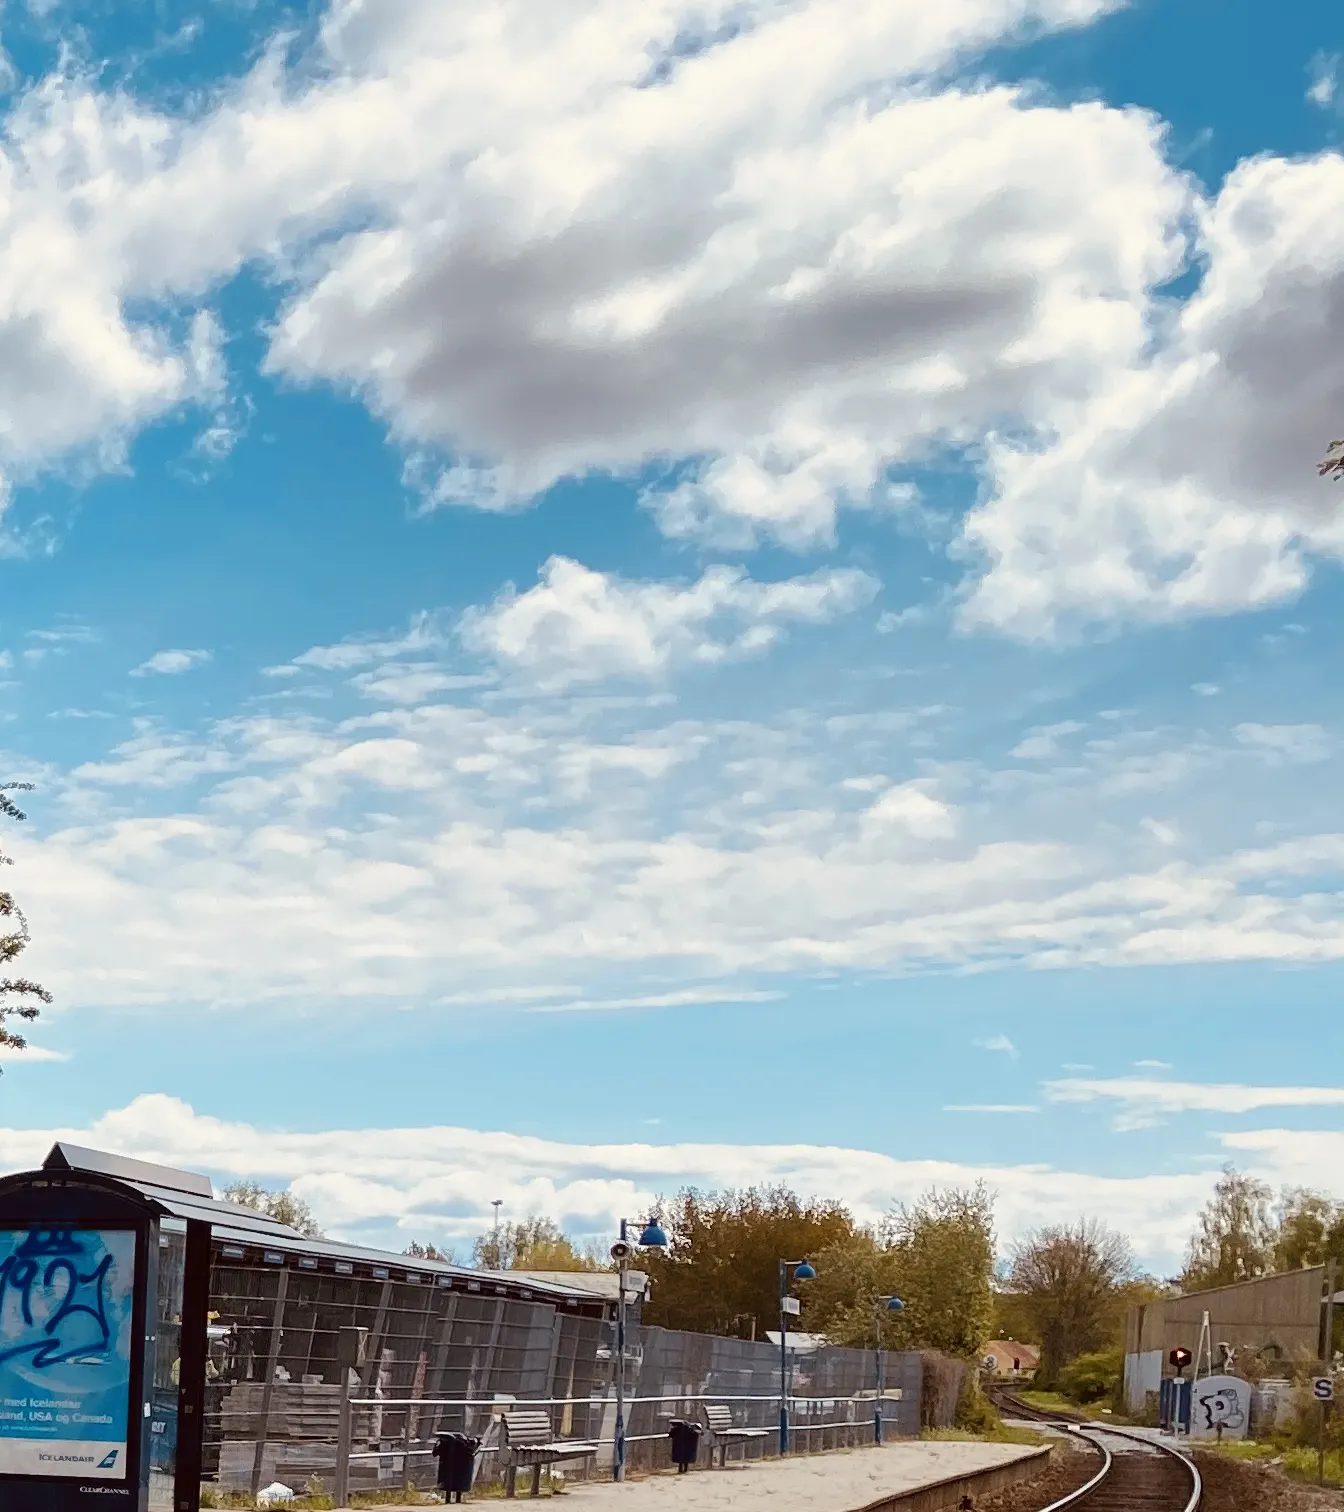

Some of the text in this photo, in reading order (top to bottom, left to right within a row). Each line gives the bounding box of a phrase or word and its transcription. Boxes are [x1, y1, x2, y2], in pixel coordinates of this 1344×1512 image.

[1314, 1379, 1333, 1398] S
[3, 1397, 27, 1407] med
[28, 1412, 53, 1422] USA
[55, 1415, 70, 1424] og
[72, 1412, 113, 1424] Canada
[38, 1453, 95, 1463] ICELANDAIR
